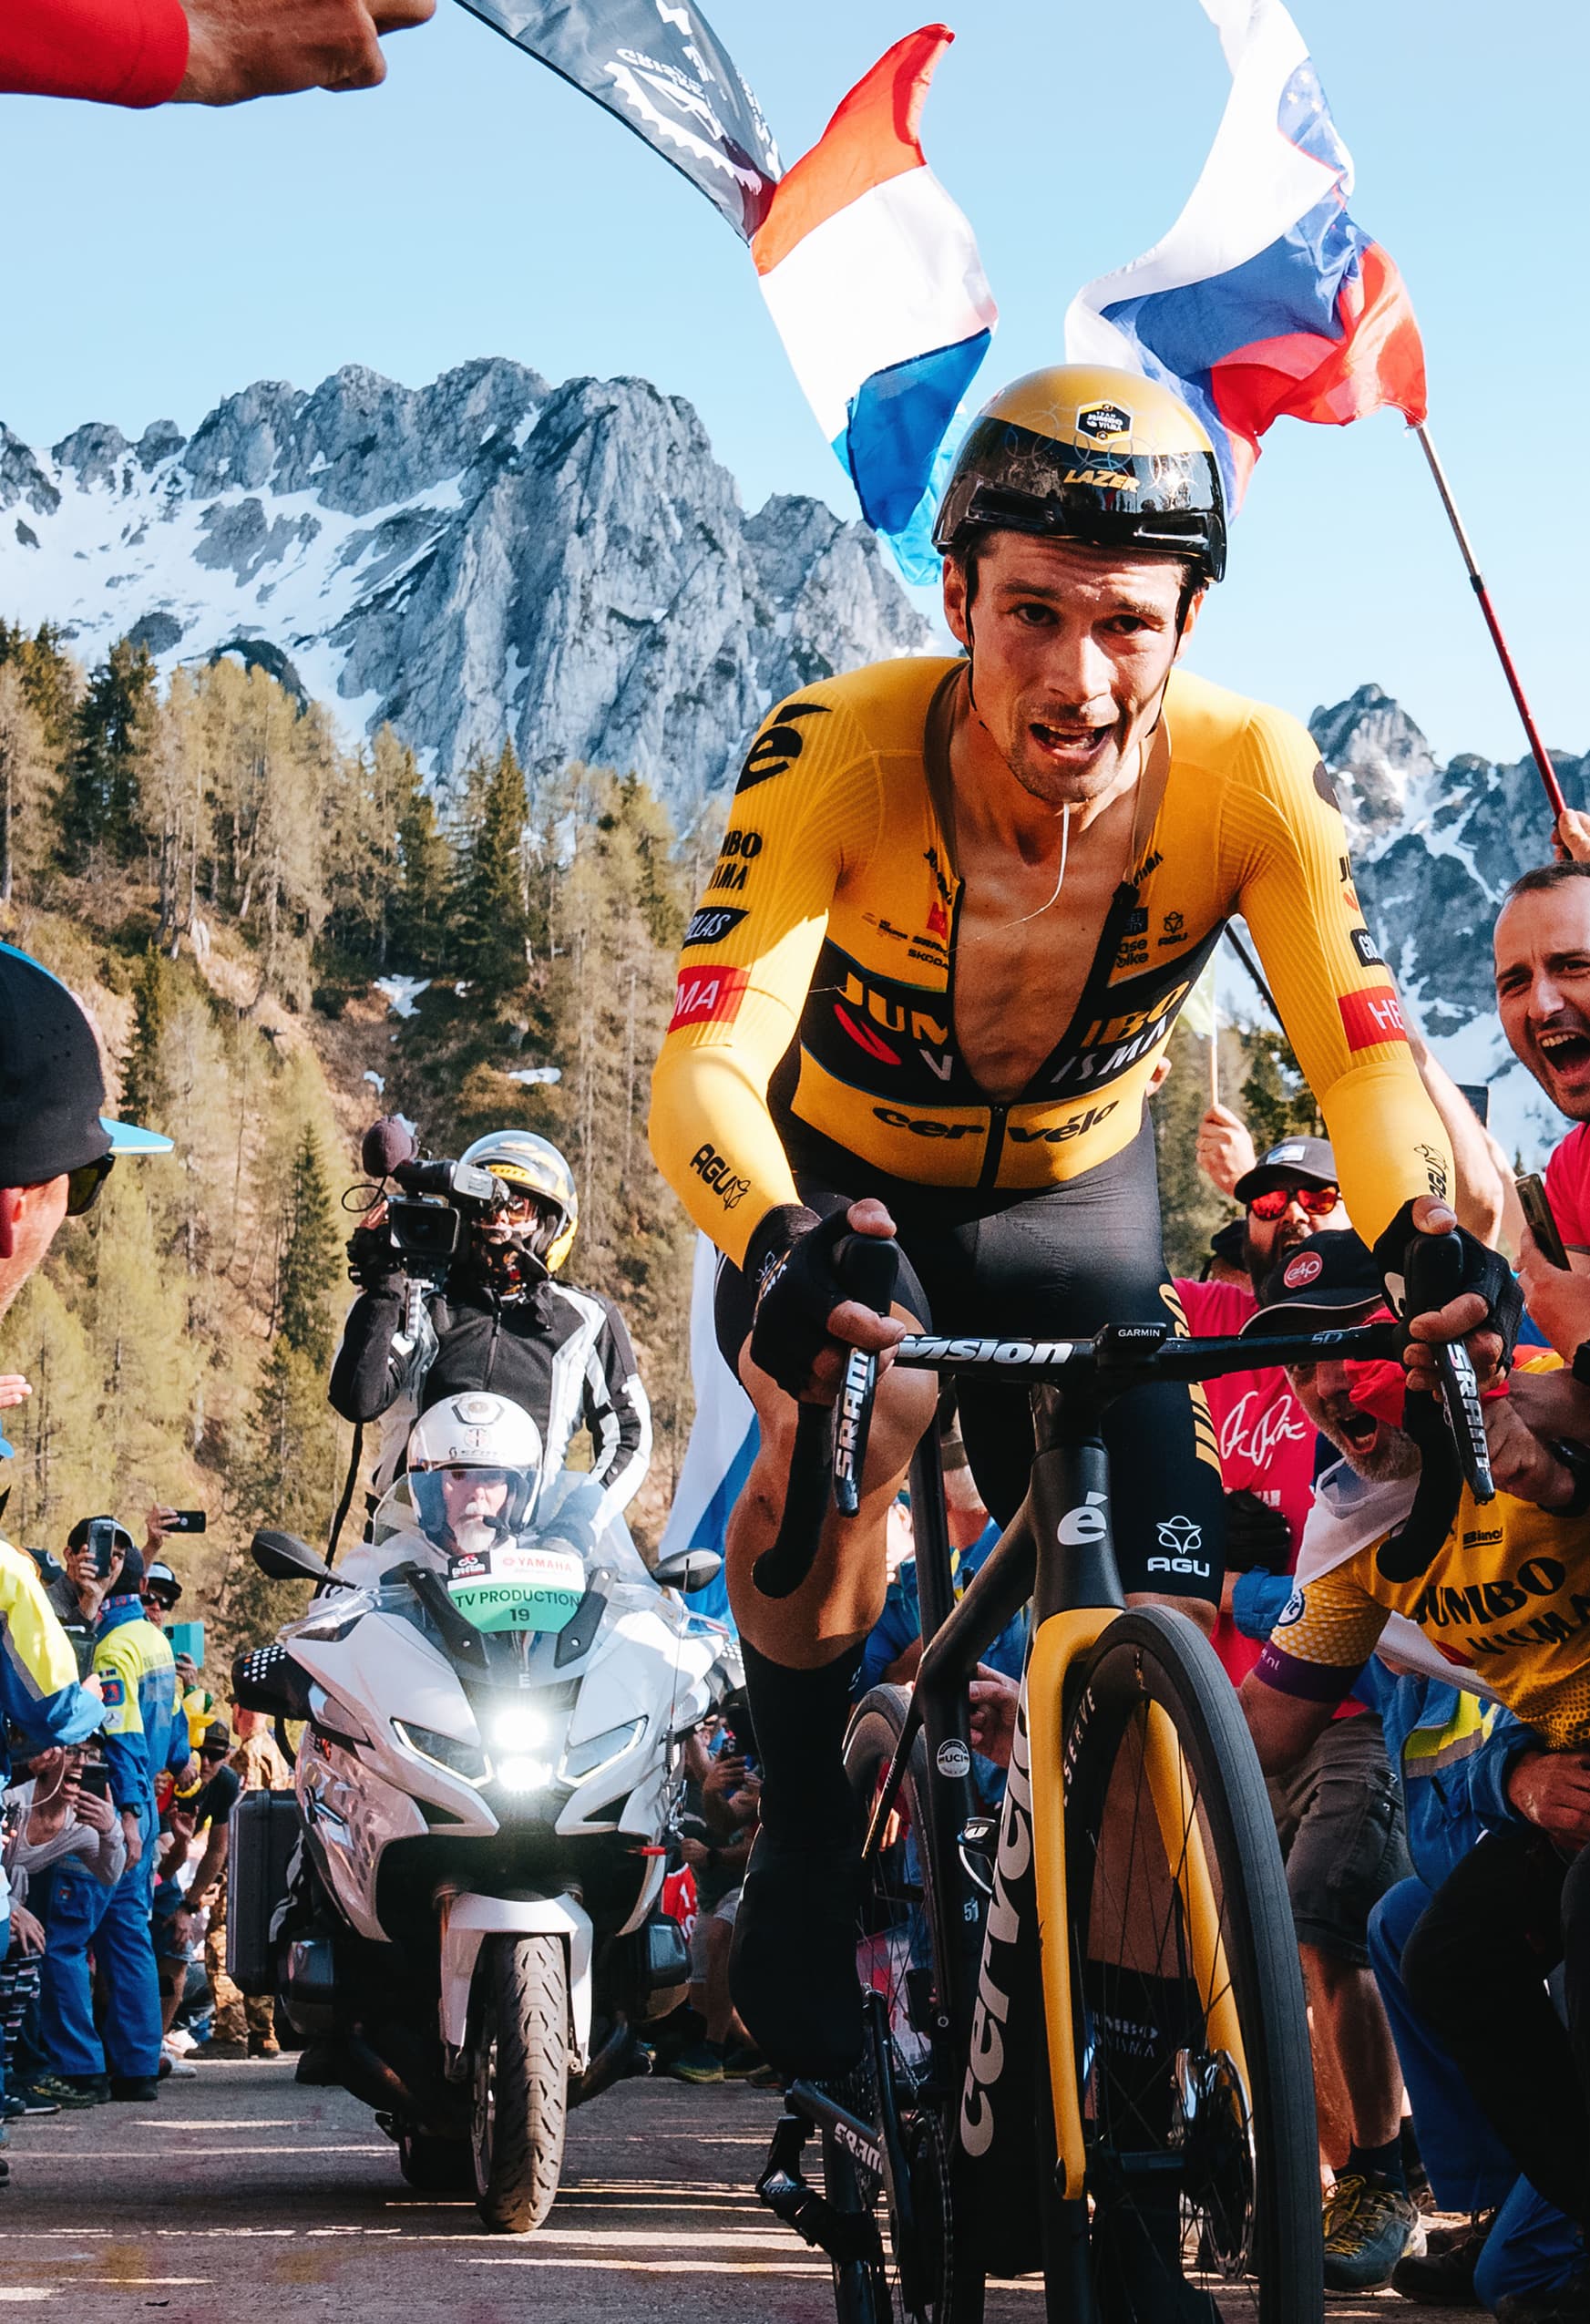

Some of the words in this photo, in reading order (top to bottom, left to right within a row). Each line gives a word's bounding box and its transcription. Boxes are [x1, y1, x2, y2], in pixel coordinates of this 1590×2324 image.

[1063, 469, 1141, 493] LAZER
[689, 1143, 732, 1196] AGU
[1118, 1328, 1161, 1338] GARMIN
[836, 1348, 869, 1481] SRAM
[1447, 1344, 1490, 1469] SRAM
[1057, 1490, 1108, 1546] é
[518, 1557, 572, 1572] YAMAHA
[1147, 1557, 1210, 1578] AGU
[456, 1593, 476, 1608] TV
[480, 1589, 580, 1607] PRODUCTION
[509, 1608, 530, 1622] 19
[945, 1754, 964, 1763] UCI
[834, 2122, 883, 2175] SRAM
